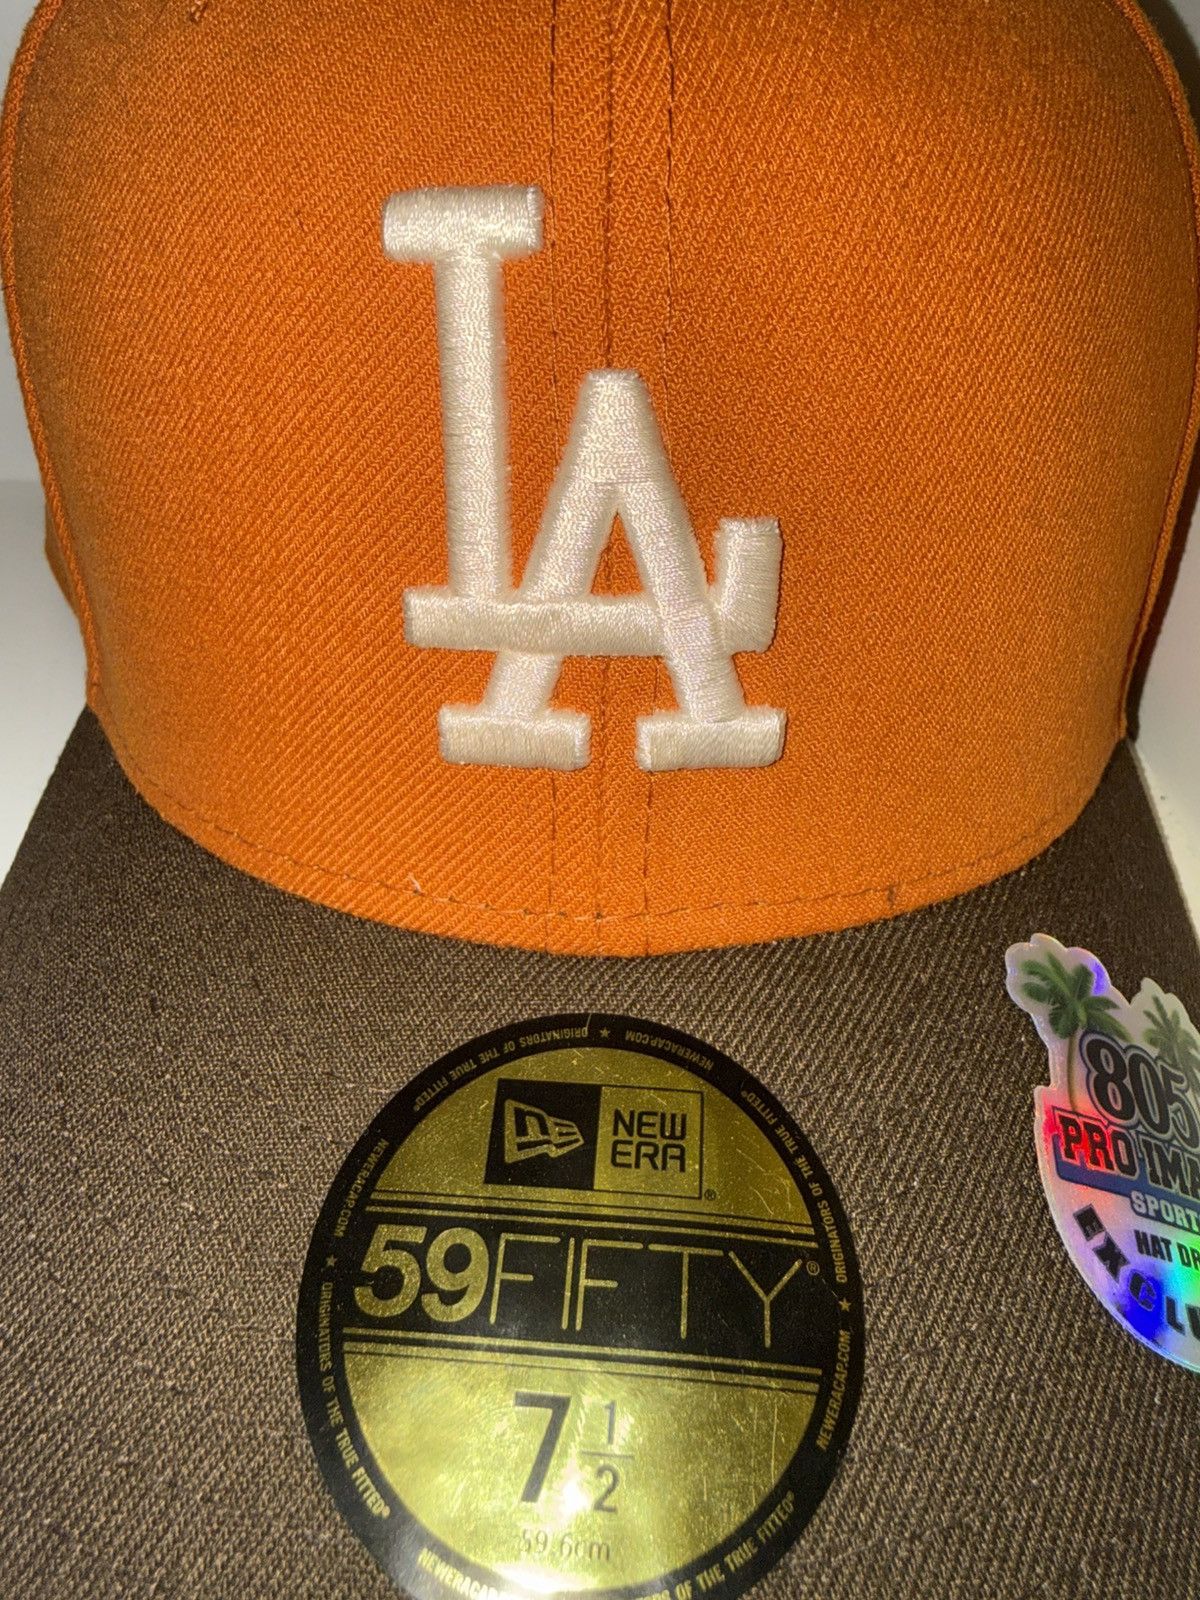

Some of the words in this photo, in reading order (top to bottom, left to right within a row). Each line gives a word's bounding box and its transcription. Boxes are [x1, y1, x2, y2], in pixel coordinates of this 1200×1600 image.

[382, 184, 787, 771] LA
[479, 1047, 501, 1065] THE
[502, 1042, 516, 1054] OF
[519, 1026, 589, 1048] ORIGINATORS
[624, 1029, 715, 1072] NEWERACAP.COM
[450, 1058, 478, 1081] TRUE
[1083, 1034, 1200, 1150] 805
[612, 1107, 688, 1142] NEW
[774, 1124, 800, 1154] TRUE
[610, 1139, 687, 1174] ERA
[795, 1154, 815, 1180] THE
[1057, 1113, 1139, 1178] PRO
[1140, 1137, 1200, 1201] IMA
[808, 1182, 824, 1196] OF
[1131, 1189, 1200, 1232] SPORT
[817, 1200, 848, 1284] ORIGINATORS
[1133, 1229, 1174, 1263] HAT
[1176, 1241, 1200, 1271] DR
[317, 1281, 334, 1373] ORIGINATORS
[321, 1375, 337, 1393] OF
[816, 1328, 851, 1451] NEWERACAP.COM
[325, 1396, 345, 1427] THE
[335, 1427, 360, 1470] TRUE
[514, 1391, 572, 1503] 7
[696, 1562, 726, 1592] THE
[724, 1537, 759, 1573] TRUE
